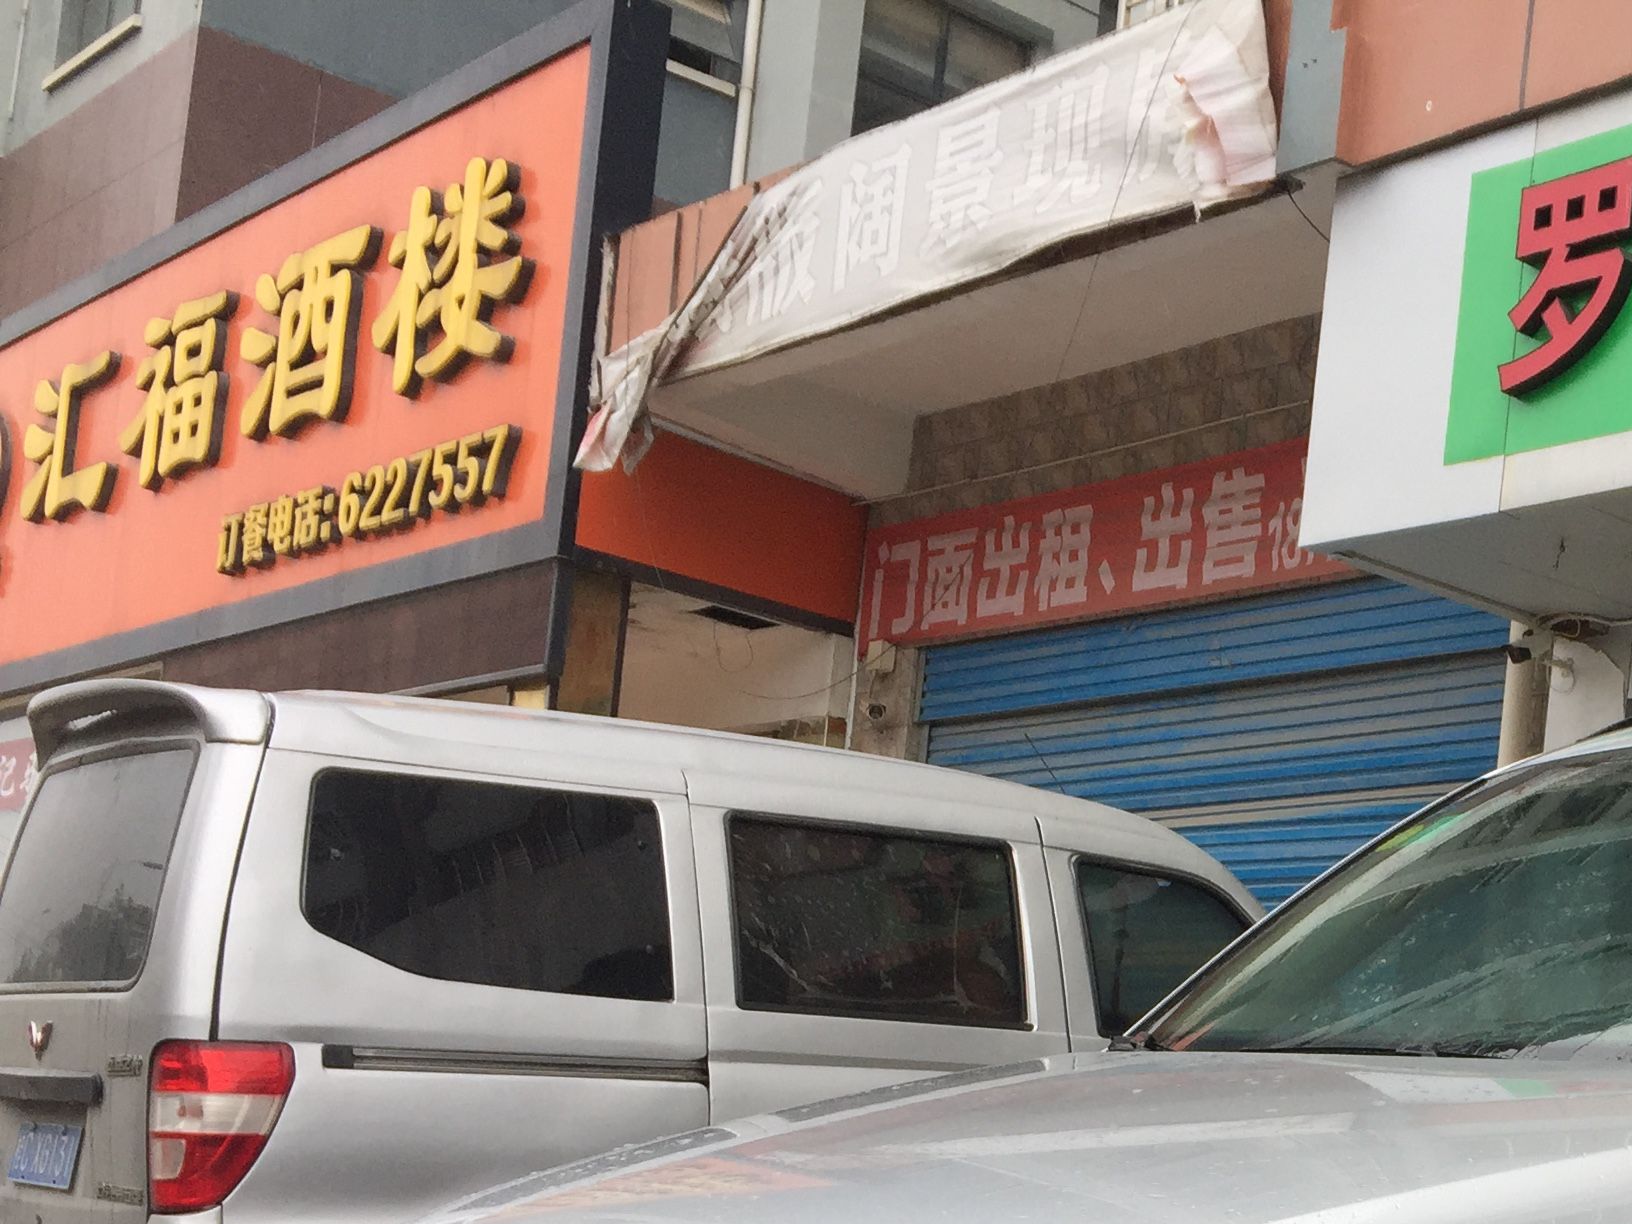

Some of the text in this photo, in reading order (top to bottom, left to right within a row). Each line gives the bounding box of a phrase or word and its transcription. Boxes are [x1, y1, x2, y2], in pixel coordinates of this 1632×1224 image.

[20, 157, 533, 523] 汇福酒楼
[216, 424, 520, 576] 订餐电话:6227557
[869, 467, 1266, 638] 门面出租、出售
